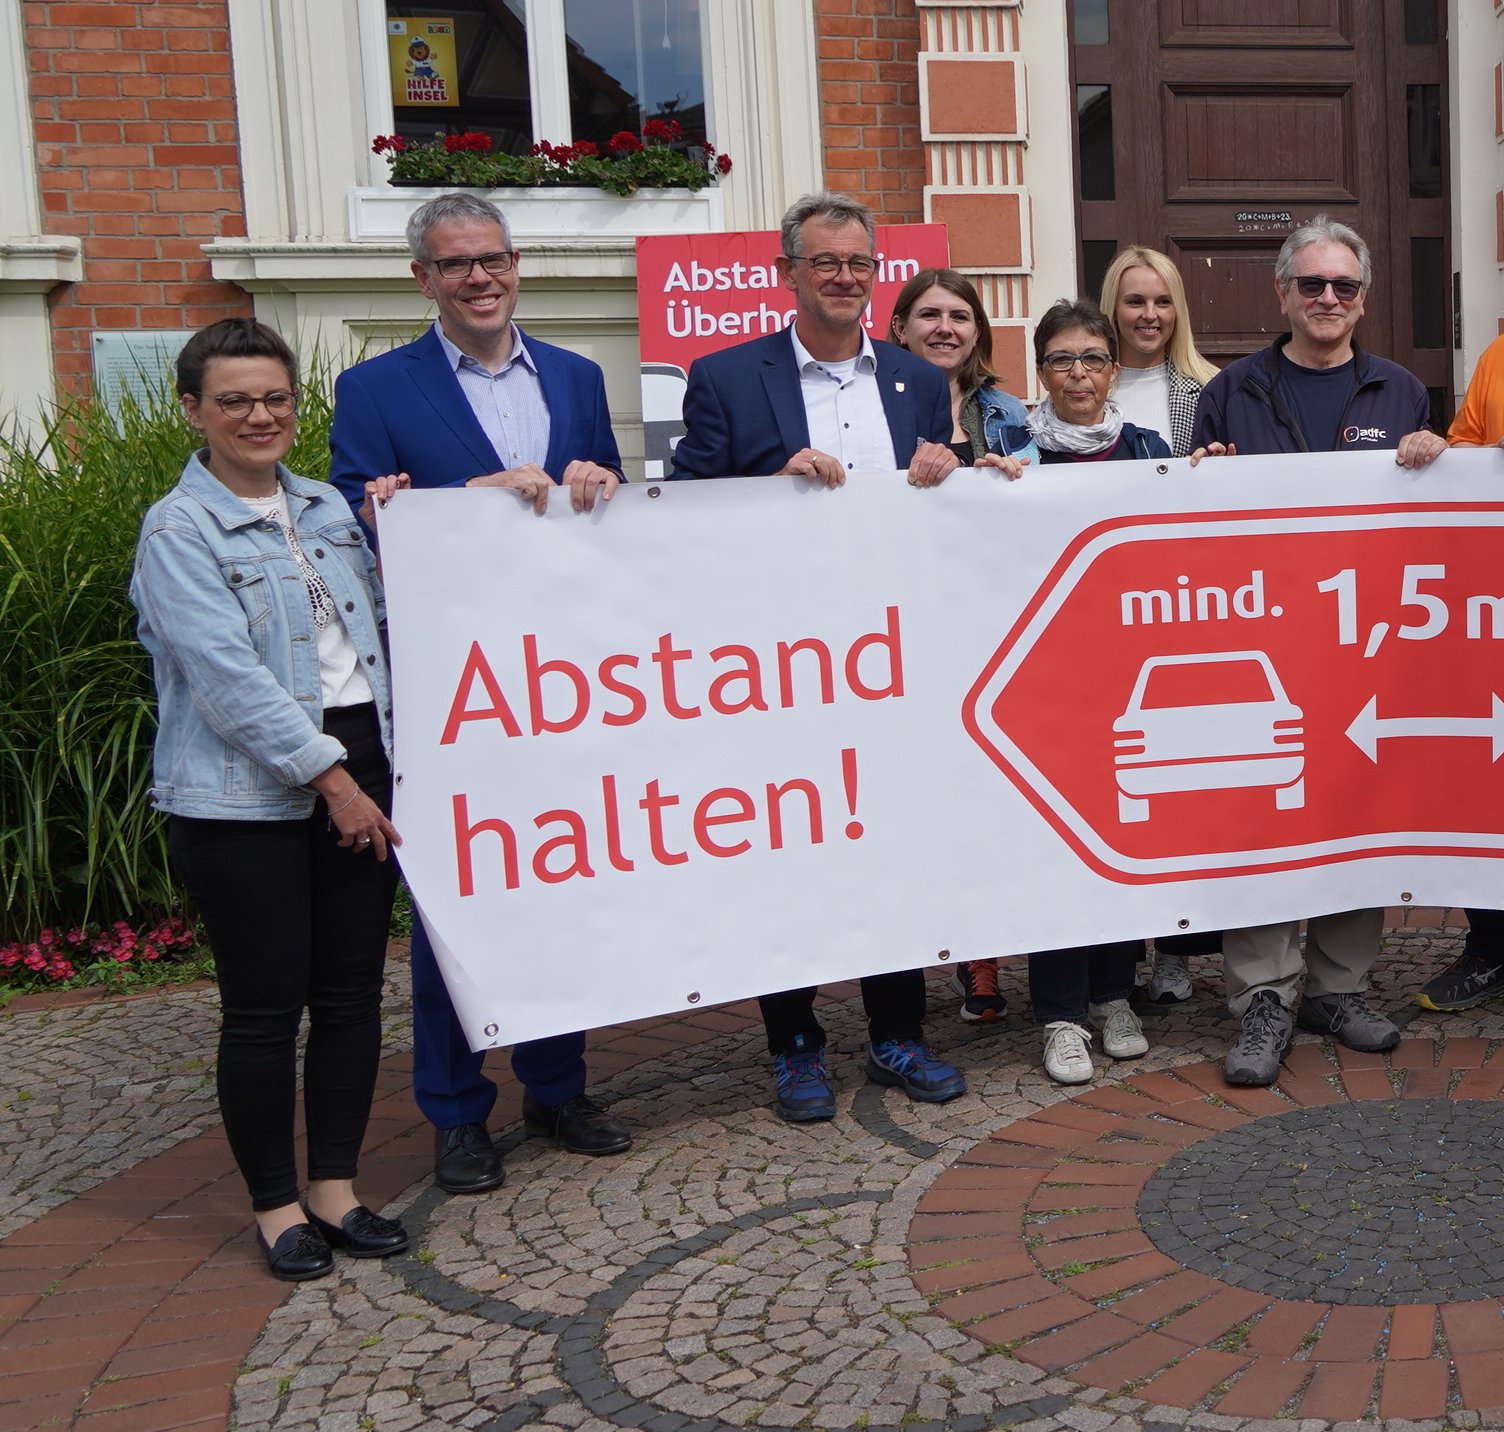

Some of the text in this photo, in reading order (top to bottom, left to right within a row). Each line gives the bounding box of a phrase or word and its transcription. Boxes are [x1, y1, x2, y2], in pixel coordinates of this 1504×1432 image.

[407, 79, 445, 89] HILFE
[408, 90, 448, 101] INSEL
[663, 260, 779, 293] Absta
[1359, 427, 1387, 439] adfc
[1120, 570, 1284, 626] mind.
[1316, 564, 1450, 659] 1,5
[439, 606, 905, 746] Abstand
[452, 748, 866, 897] halten!
